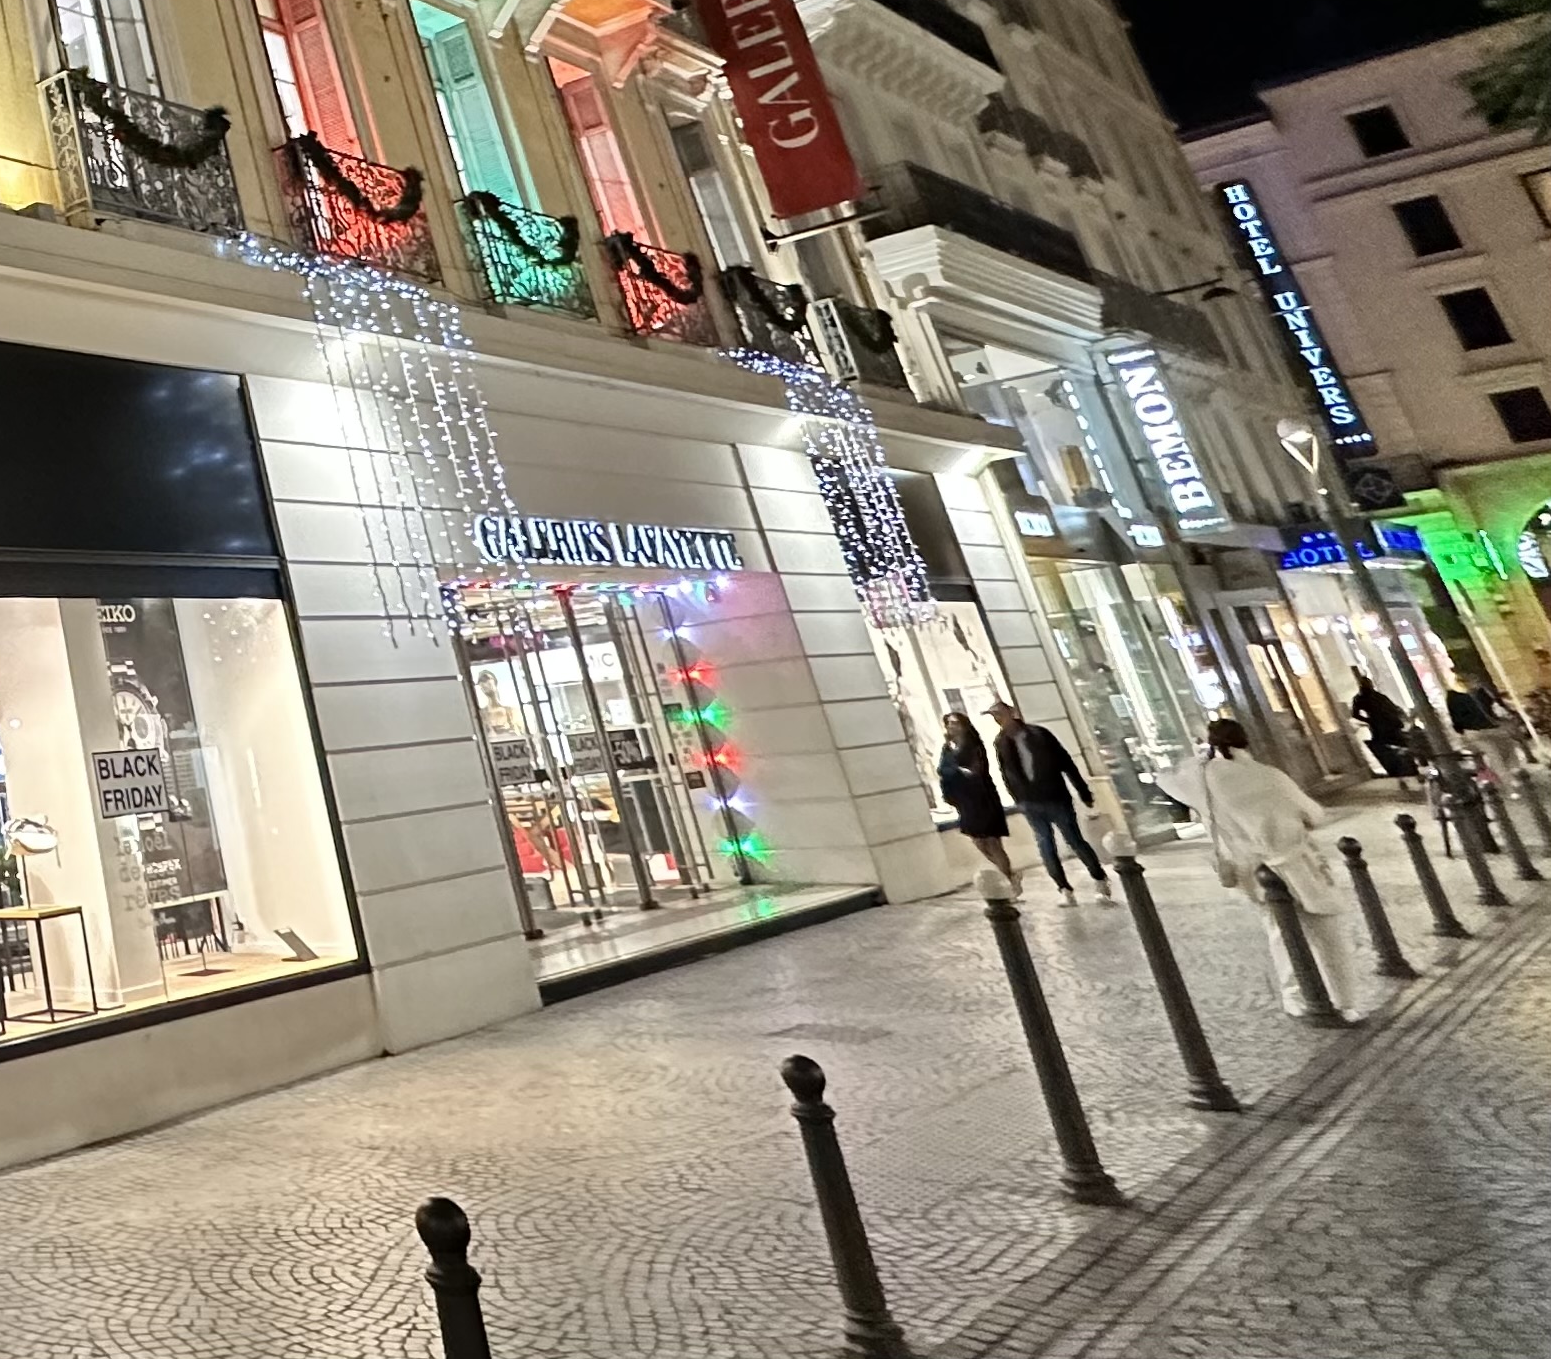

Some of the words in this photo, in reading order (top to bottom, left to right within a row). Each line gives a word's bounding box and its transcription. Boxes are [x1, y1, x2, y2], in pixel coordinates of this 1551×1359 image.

[1223, 184, 1282, 275] HOTEL
[1273, 291, 1356, 424] UNIVERS
[1119, 366, 1213, 513] BEMON
[97, 604, 136, 622] EIKO
[97, 754, 160, 780] BLACK
[103, 785, 163, 812] FRIDAY
